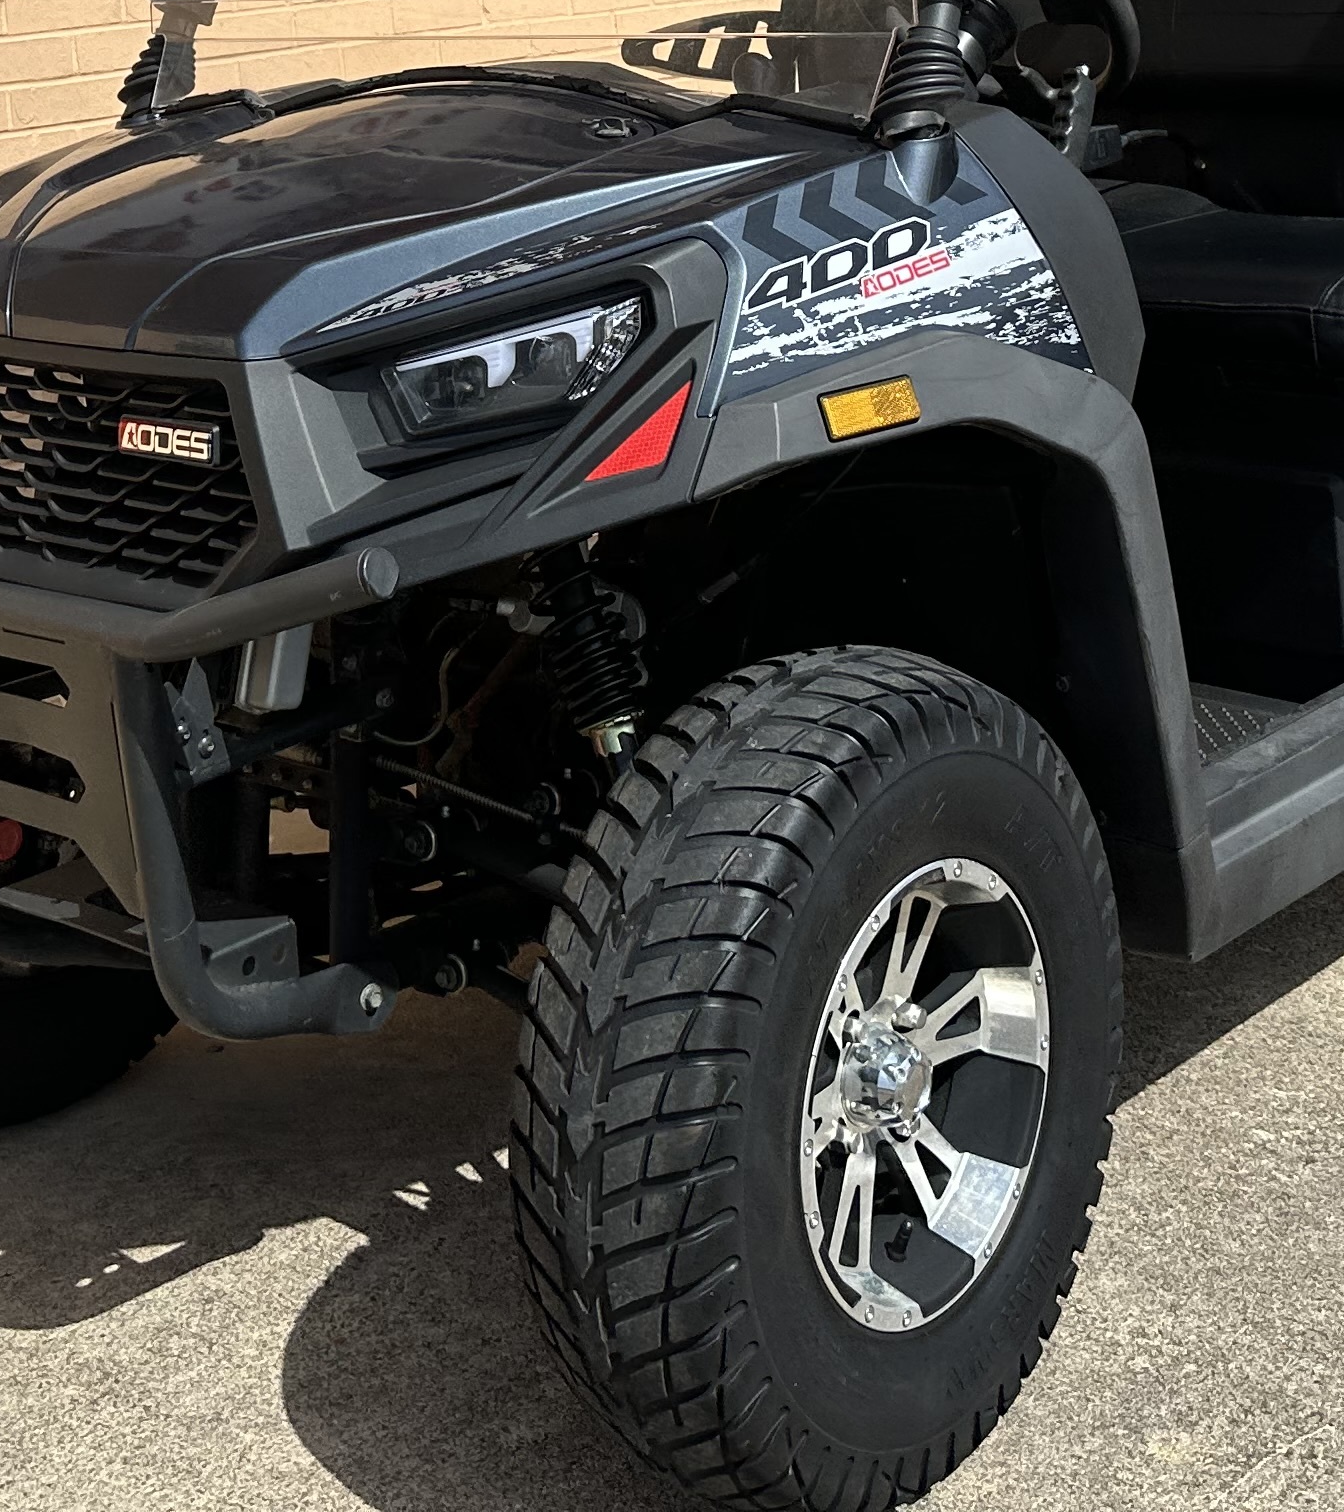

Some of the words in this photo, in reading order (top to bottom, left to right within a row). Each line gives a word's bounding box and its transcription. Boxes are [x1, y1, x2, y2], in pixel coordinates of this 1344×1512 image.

[742, 216, 931, 315] 400
[860, 249, 951, 299] AODES
[121, 422, 210, 460] AODES
